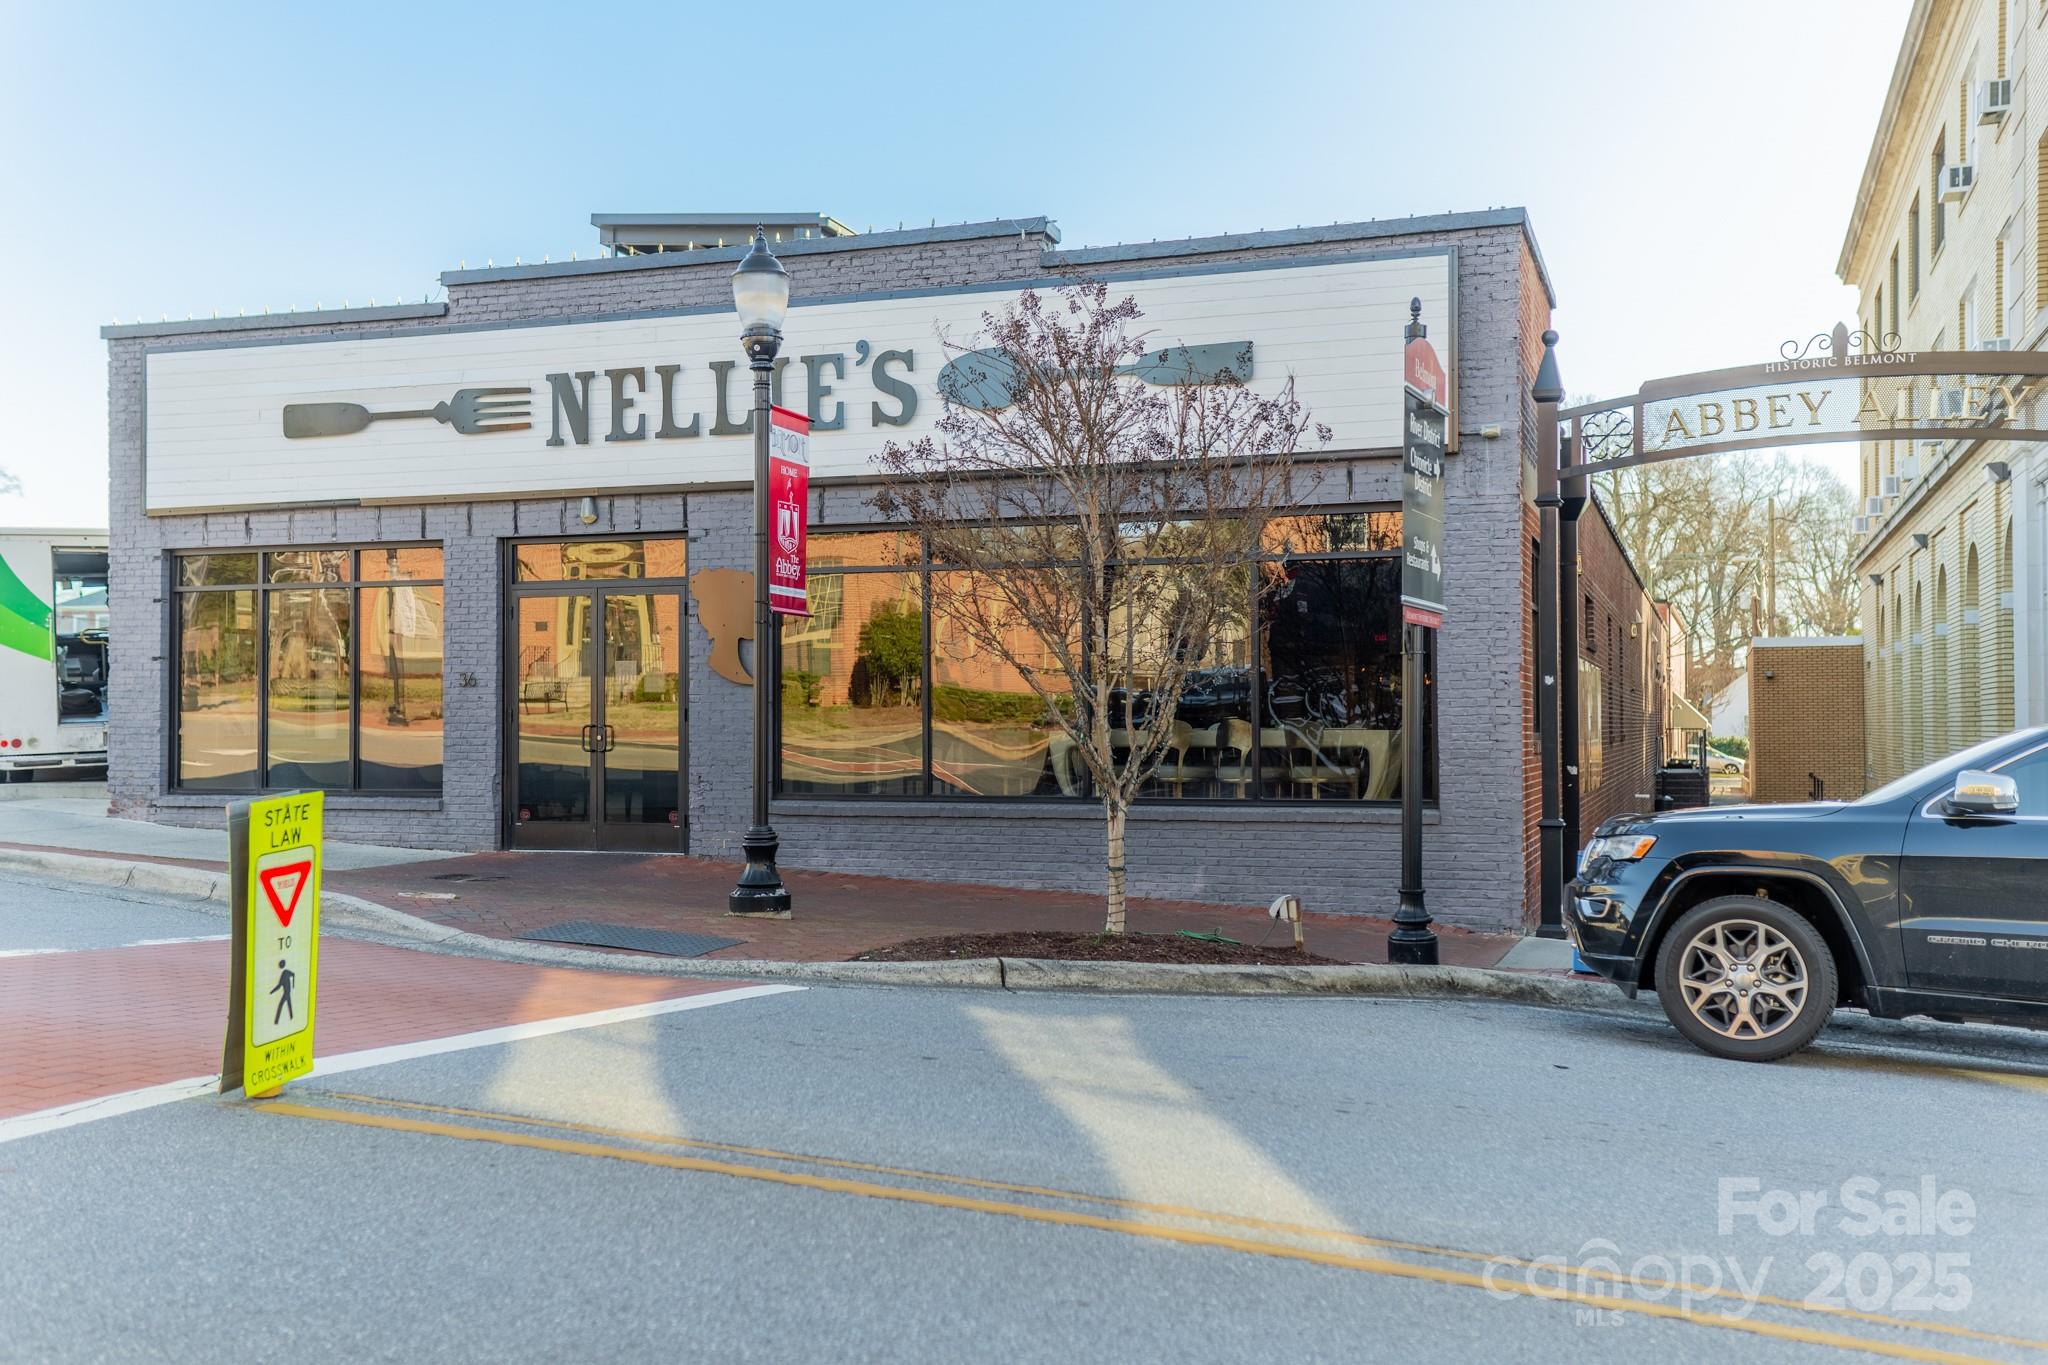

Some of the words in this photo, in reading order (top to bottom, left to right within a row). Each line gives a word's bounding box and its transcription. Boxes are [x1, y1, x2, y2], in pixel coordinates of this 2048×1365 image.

[1765, 356, 1838, 373] HISTORIC
[1844, 352, 1917, 366] BELMONT
[546, 339, 918, 446] NELLIE'S
[1662, 390, 1832, 443] ABBEY
[1851, 384, 2034, 424] ALLEY
[1410, 412, 1423, 437] River
[1423, 420, 1441, 449] District
[1410, 446, 1433, 477] Chronicle
[1414, 470, 1432, 497] District
[1413, 536, 1426, 554] Shops
[775, 556, 801, 580] Abbey
[790, 554, 800, 564] The
[1406, 551, 1430, 571] Restaurants
[459, 673, 476, 688] 36
[264, 803, 310, 827] STATE
[271, 827, 301, 848] LAW
[278, 935, 292, 950] TO
[265, 1041, 295, 1062] WITHIN
[251, 1055, 306, 1086] CROSSWALK
